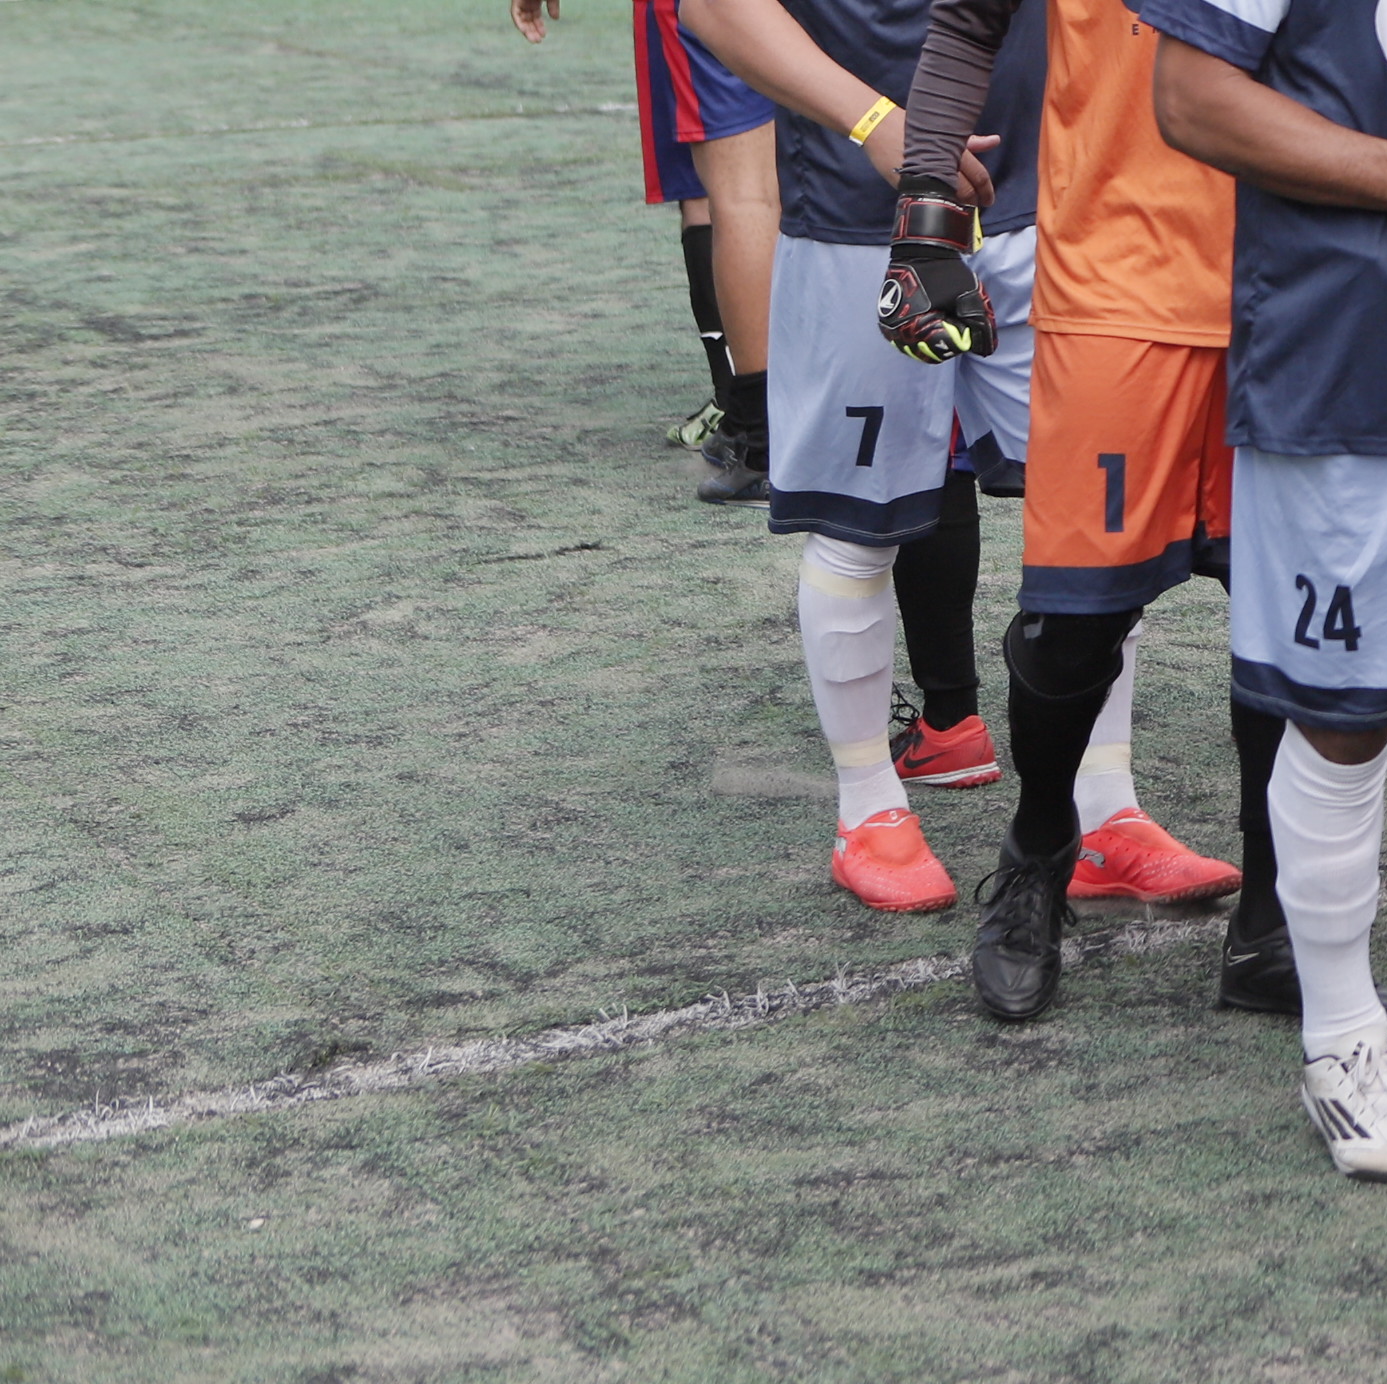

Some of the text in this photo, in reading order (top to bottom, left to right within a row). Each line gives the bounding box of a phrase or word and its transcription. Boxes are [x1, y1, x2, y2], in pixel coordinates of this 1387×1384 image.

[845, 405, 884, 467] 7
[1097, 453, 1126, 532] 1
[1294, 573, 1361, 651] 24
